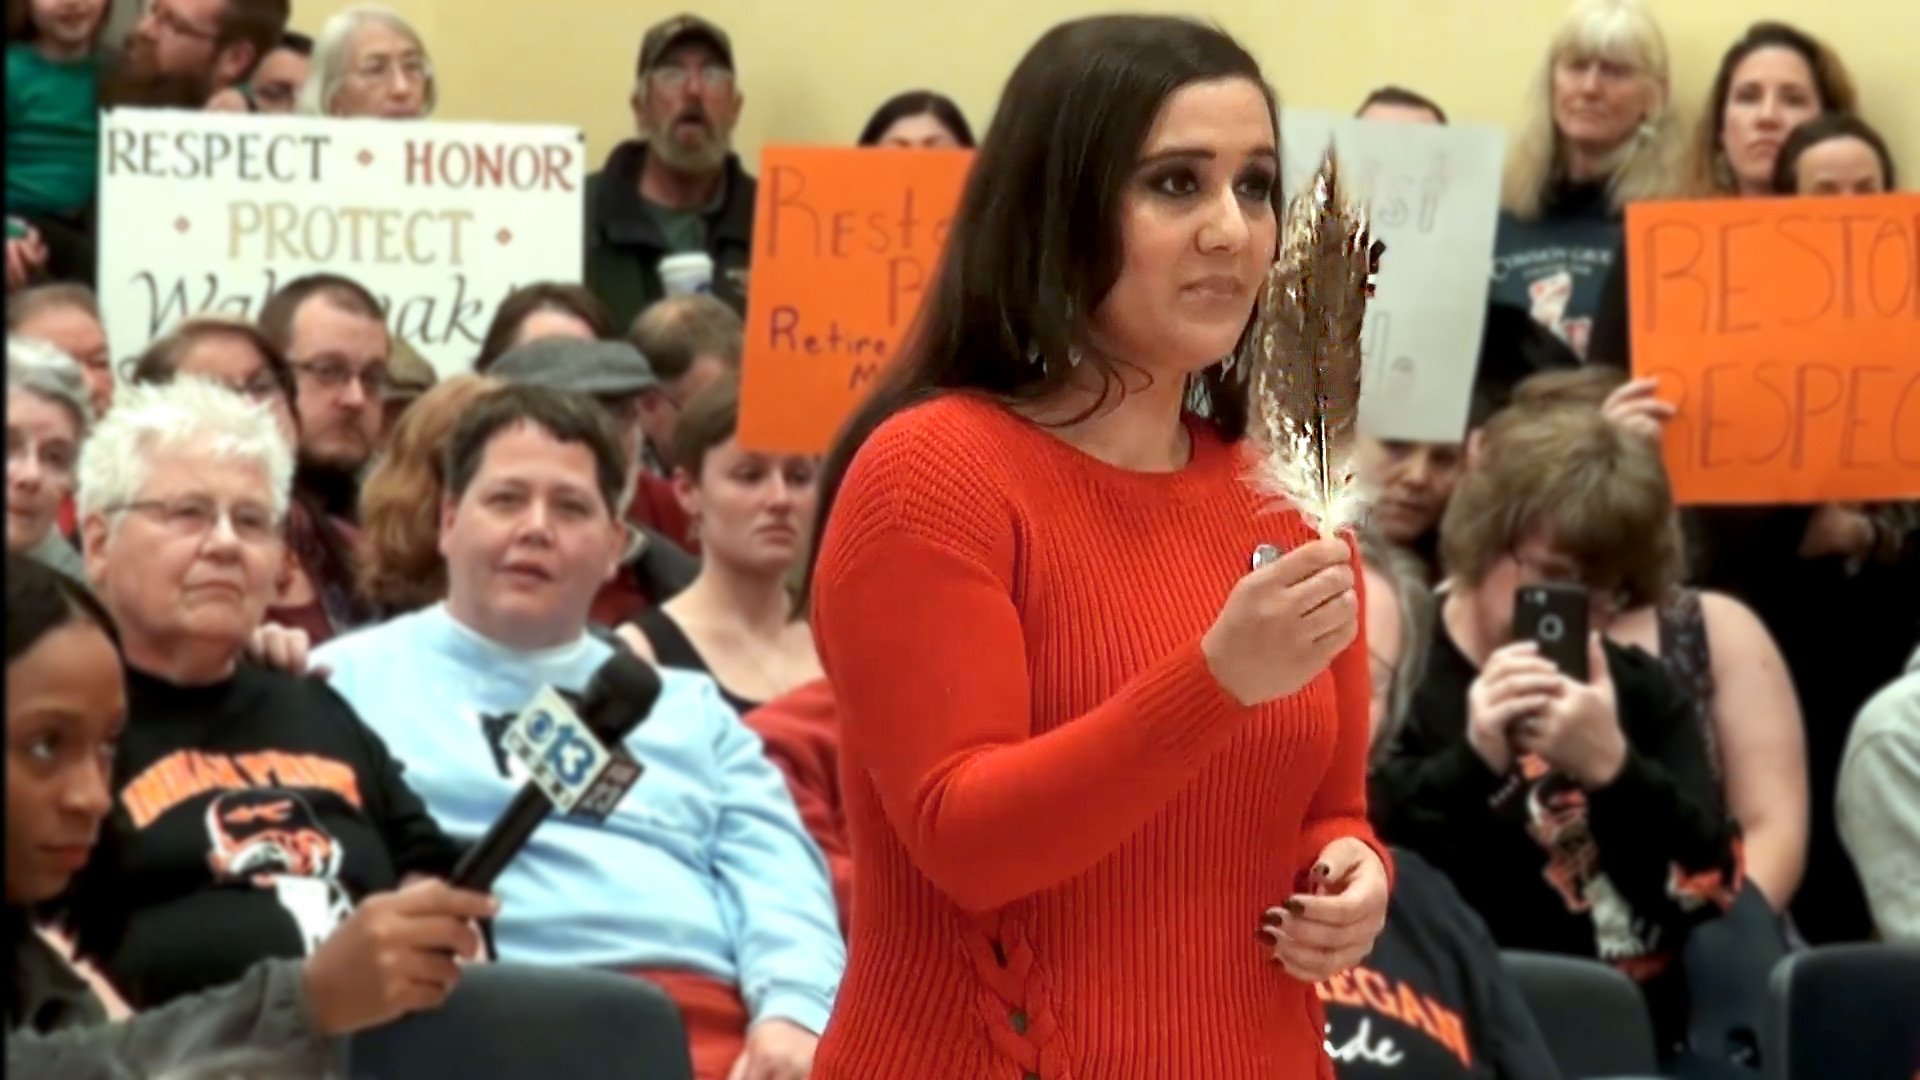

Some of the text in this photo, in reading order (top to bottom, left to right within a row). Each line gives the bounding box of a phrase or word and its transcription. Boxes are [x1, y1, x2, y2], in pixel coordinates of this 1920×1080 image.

[106, 127, 575, 193] RESPECT HONOR
[227, 199, 474, 266] PROTECT
[770, 304, 886, 353] Retire
[544, 724, 598, 787] 13
